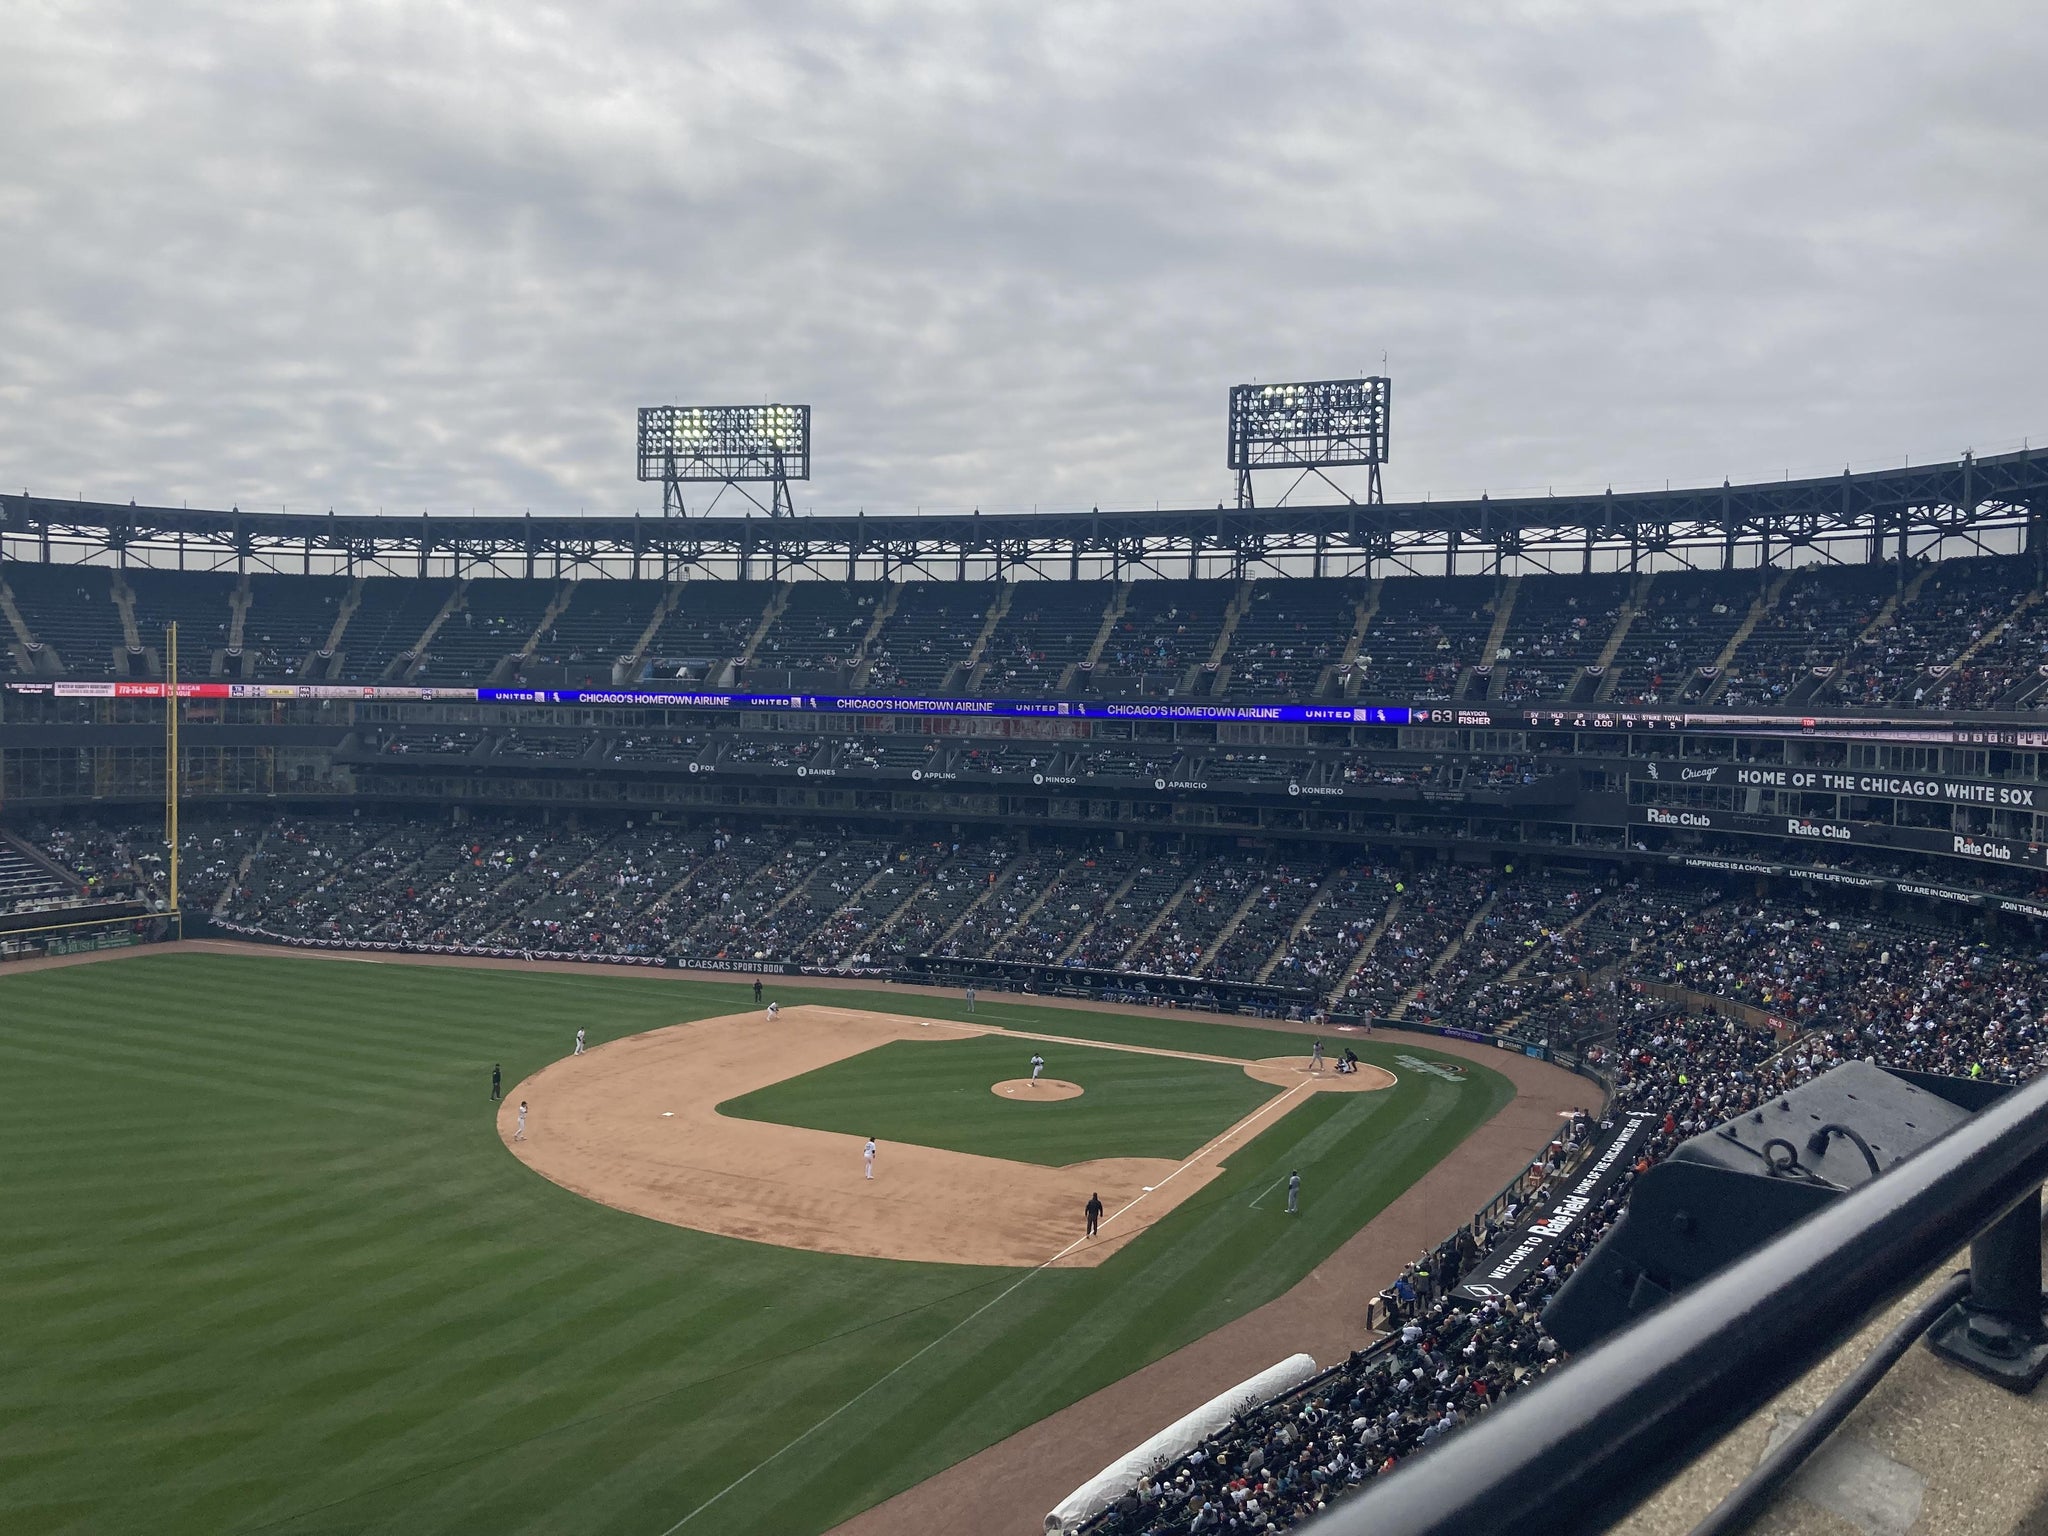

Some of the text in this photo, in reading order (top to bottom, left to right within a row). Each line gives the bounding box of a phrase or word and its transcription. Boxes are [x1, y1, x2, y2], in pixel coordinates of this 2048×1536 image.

[579, 693, 730, 706] CHICAGO'S HOMETOWN AIRLINE
[837, 699, 993, 712] CHICAGO'S HOMETOWN AIRLINE
[1015, 704, 1056, 712] UNITED
[1107, 704, 1280, 719] CHICAGO'S HOMETOWN AIRLINE
[1305, 710, 1351, 719] UNITED
[1431, 709, 1452, 723] 63
[1458, 717, 1490, 725] FISHER
[1554, 719, 1560, 727] 2
[1594, 720, 1613, 728] 0.00
[808, 768, 836, 776] BAINES
[1681, 766, 1719, 782] Chicago
[1168, 781, 1208, 789] APARICIO
[1302, 787, 1344, 795] KONERKO
[1738, 770, 2034, 806] HOME OF THE CHICAGO WHITE SOX
[1647, 809, 1711, 827] Rate Club
[1788, 820, 1820, 836] Rate
[1821, 825, 1850, 840] Club
[1954, 836, 2011, 860] Rate Club
[1685, 859, 1730, 869] HAPPINESS
[1745, 865, 1772, 874] CHOICE
[1808, 872, 1824, 880] THE
[1824, 874, 1840, 882] LIFE
[1841, 876, 1856, 884] YOU
[1897, 884, 1913, 893] YOU
[1914, 887, 1930, 895] ARE
[2000, 901, 2018, 911] JOIN
[2018, 904, 2033, 914] THE
[687, 959, 784, 974] CAESARS SPORTS BOOK
[1488, 1118, 1643, 1279] WELCOME TO Rate Field HOME OF THE CHICAGO WHITE SOX
